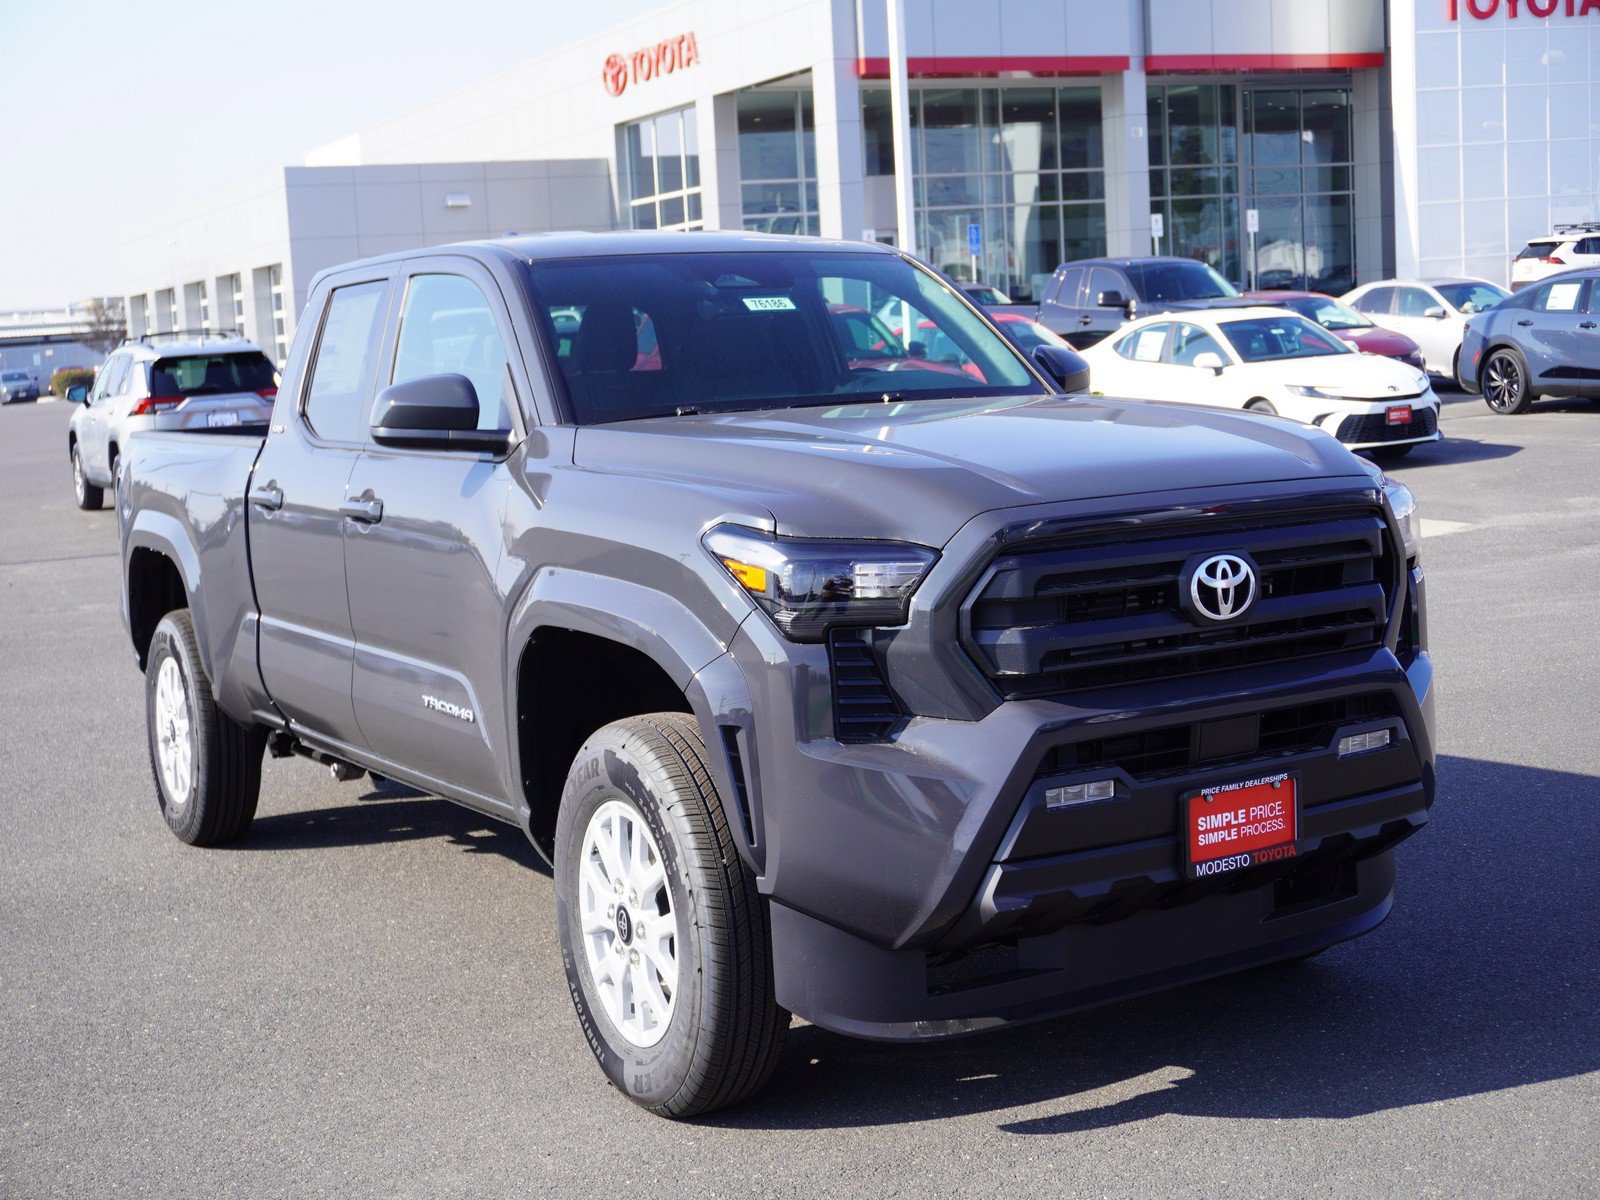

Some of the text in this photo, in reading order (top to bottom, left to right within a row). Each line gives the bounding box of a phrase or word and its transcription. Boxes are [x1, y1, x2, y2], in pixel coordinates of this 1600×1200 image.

[627, 31, 700, 84] TOYOTA
[421, 694, 474, 722] TACOMA
[1200, 773, 1287, 796] PRICE FAMILY DEALERSHIPS
[1197, 802, 1285, 831] SIMPLE PRICE.
[1198, 818, 1286, 846] SIMPLE PROCESS.
[1196, 845, 1296, 877] MODESTO TOYOTA
[569, 981, 606, 1063] TERRITORY
